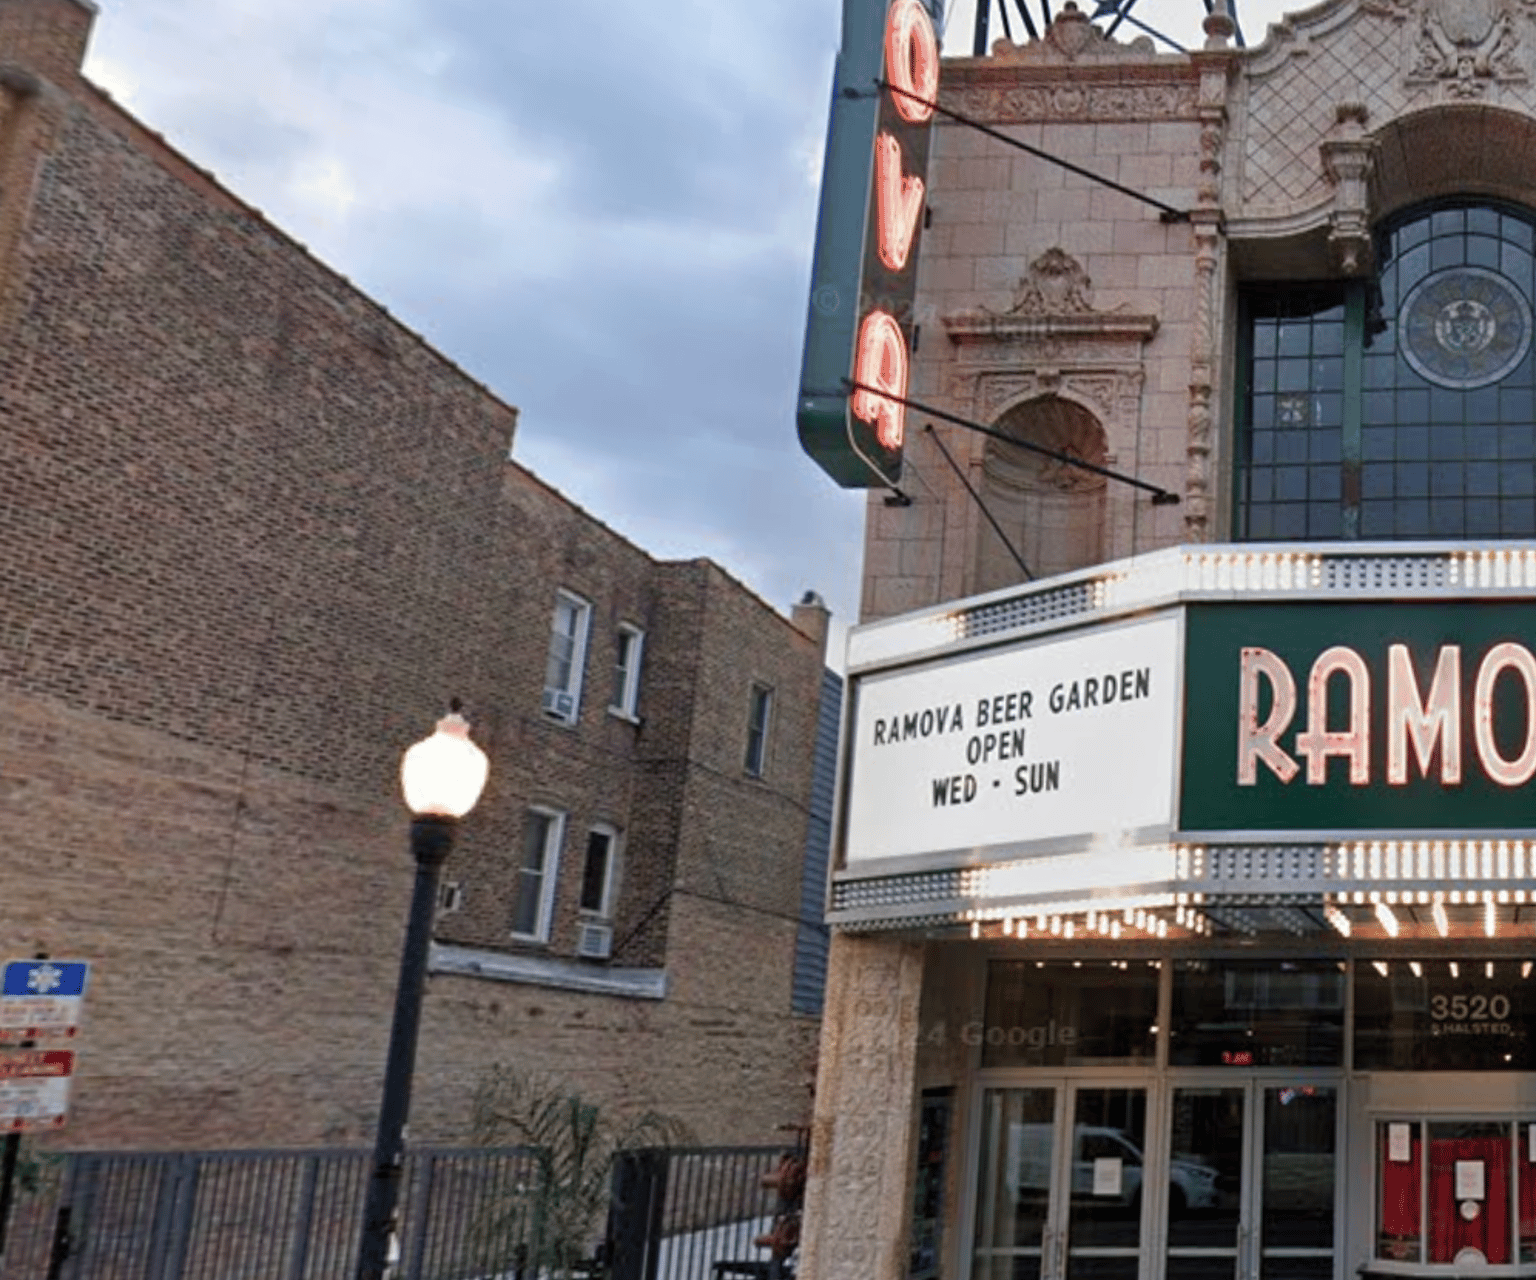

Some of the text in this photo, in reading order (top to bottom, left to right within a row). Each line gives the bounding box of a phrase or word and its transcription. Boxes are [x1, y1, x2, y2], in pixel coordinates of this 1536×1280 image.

[873, 667, 1151, 746] RAMOVA BEER GARDEN
[966, 728, 1026, 765] OPEN
[932, 774, 977, 808] WED
[1015, 761, 1061, 796] SUN
[1430, 994, 1511, 1021] 3520
[1442, 1022, 1511, 1035] HALSTED
